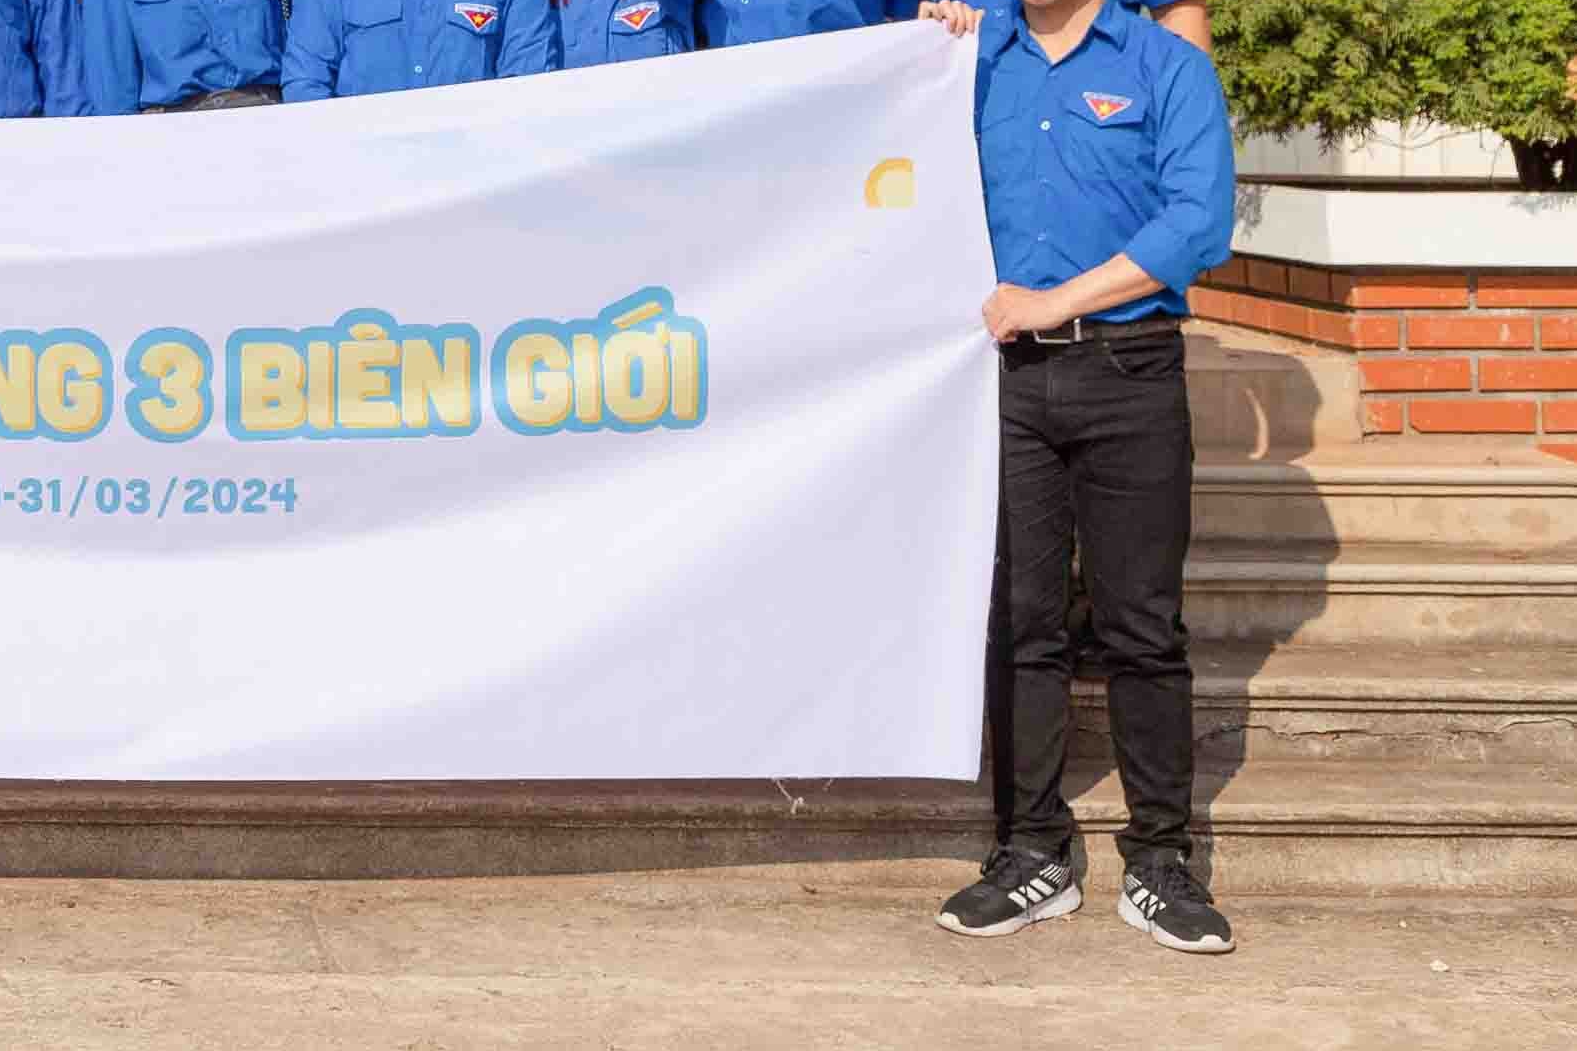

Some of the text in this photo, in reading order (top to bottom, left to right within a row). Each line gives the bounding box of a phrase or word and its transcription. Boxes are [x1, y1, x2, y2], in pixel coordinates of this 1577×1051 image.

[127, 331, 211, 440] 3
[227, 309, 480, 439] BIÊN
[493, 287, 706, 435] GIỚI
